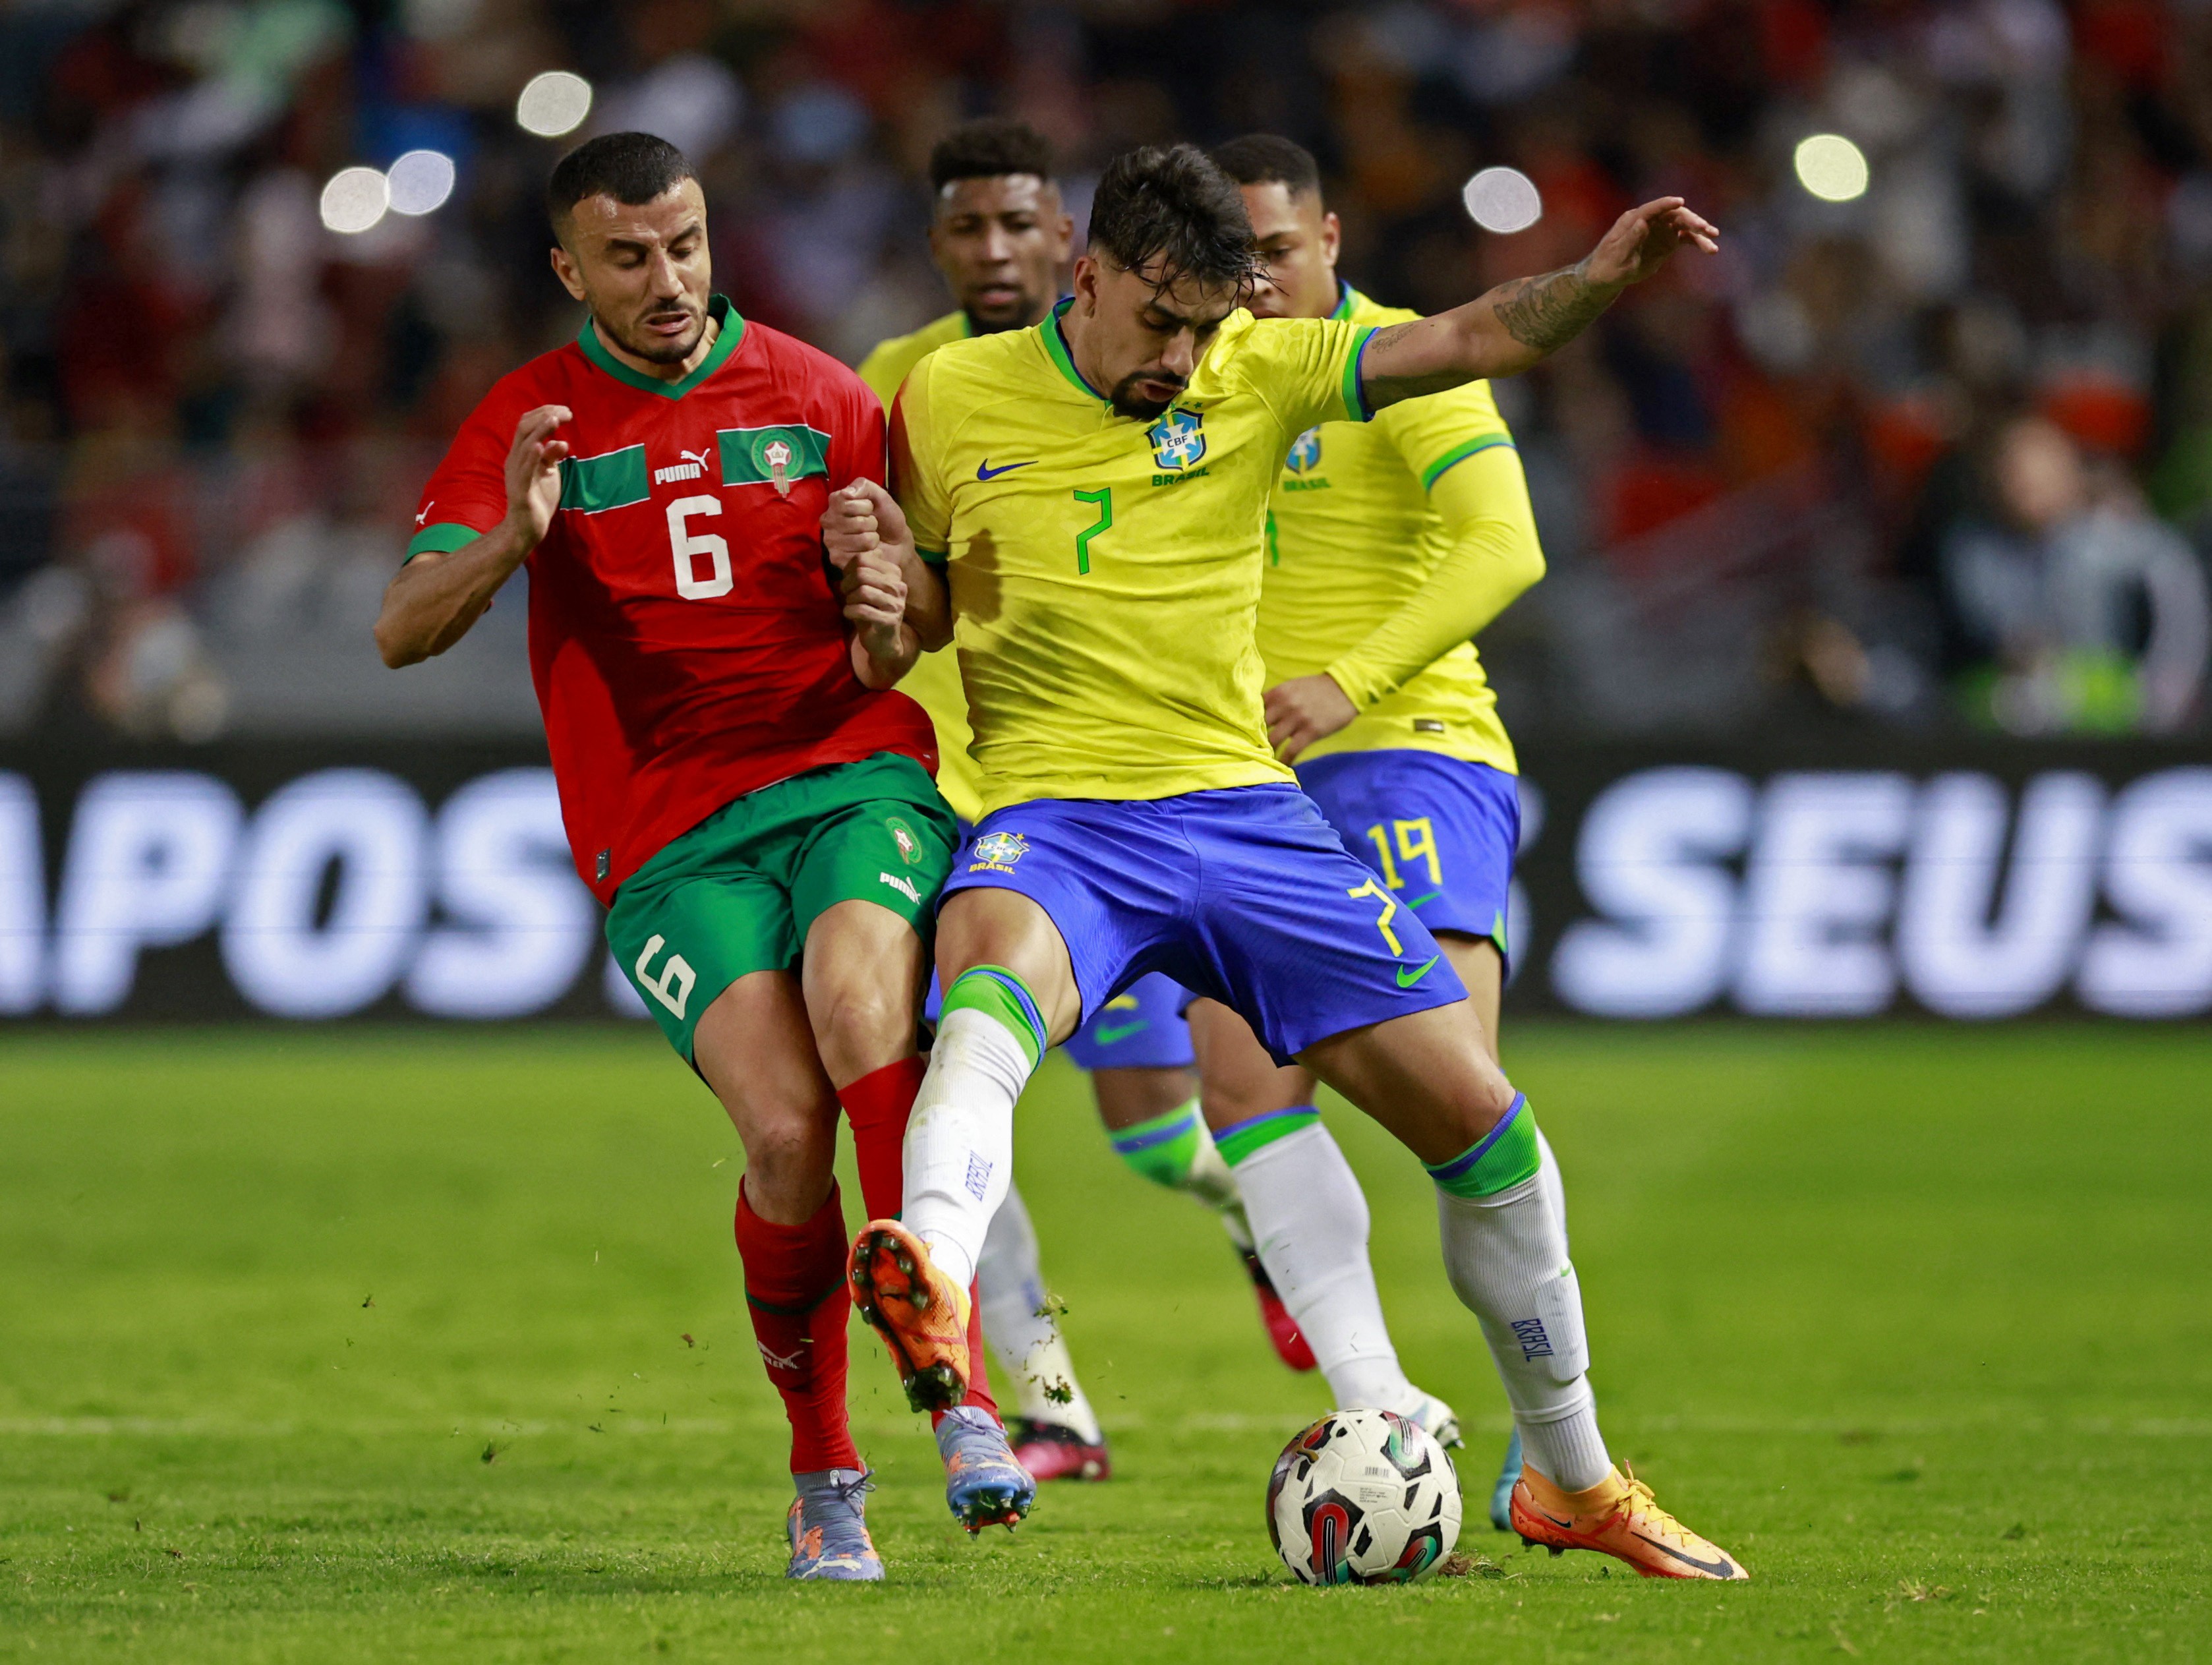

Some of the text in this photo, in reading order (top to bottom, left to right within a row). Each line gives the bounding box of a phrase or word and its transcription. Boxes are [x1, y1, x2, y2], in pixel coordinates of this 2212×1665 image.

[1167, 435, 1188, 448] CBF
[655, 463, 701, 484] PUMA
[1152, 467, 1209, 486] BRASIL
[666, 494, 734, 600] 6
[1074, 487, 1112, 575] 7
[969, 862, 1016, 875] BRASIL
[1367, 817, 1443, 890] 19
[0, 767, 659, 1020] POS
[880, 871, 916, 903] PUMA
[1347, 877, 1403, 958] 7
[1549, 765, 2212, 1020] SEUS
[635, 933, 697, 1022] 6
[965, 1150, 993, 1202] BRASIL
[1510, 1318, 1554, 1362] BRASIL
